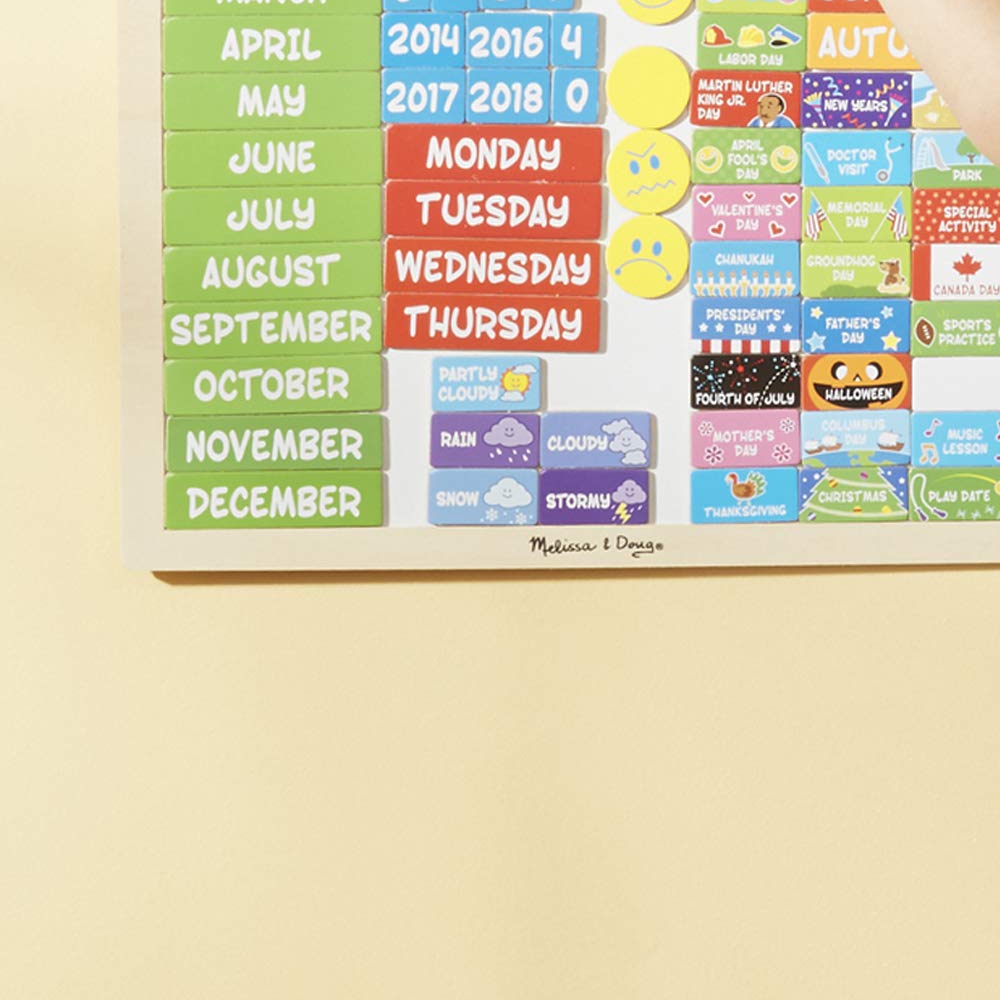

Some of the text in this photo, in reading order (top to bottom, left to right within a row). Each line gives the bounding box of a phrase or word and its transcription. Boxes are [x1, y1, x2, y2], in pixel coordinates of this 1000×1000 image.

[220, 28, 322, 61] APRIL
[387, 24, 460, 55] 2014
[469, 25, 543, 58] 2016
[561, 25, 582, 59] 4
[817, 25, 915, 60] AUTU
[719, 53, 783, 68] LABOR DAY
[698, 78, 793, 94] MARTIN LUTHER
[237, 84, 306, 118] MAY
[386, 82, 459, 114] 2017
[469, 82, 543, 113] 2018
[565, 79, 589, 112] 0
[697, 92, 747, 108] KING JR.
[824, 99, 888, 114] NEW YEARS
[697, 108, 720, 121] DAY
[730, 139, 764, 153] APRIL
[228, 141, 316, 174] JUNE
[426, 136, 561, 172] MONDAY
[727, 153, 768, 167] FOOL'S
[827, 149, 877, 162] DOCTOR
[736, 167, 760, 180] DAY
[838, 162, 869, 177] VISIT
[953, 168, 983, 182] PARK
[227, 197, 316, 232] JULY
[416, 192, 569, 229] TUESDAY
[711, 203, 783, 218] VALENTINE'S
[827, 201, 887, 215] MEMORIAL
[944, 206, 993, 220] SPECIAL
[736, 217, 760, 231] DAY
[846, 214, 868, 228] DAY
[938, 218, 997, 234] ACTIVITY
[715, 252, 773, 266] CHANUKAH
[806, 254, 875, 269] GROUNDHOG
[201, 254, 341, 289] AUGUST
[395, 250, 592, 287] WEDNESDAY
[832, 267, 855, 282] DAY
[934, 284, 1000, 298] CANADA DAY
[171, 310, 372, 345] SEPTEMBER
[404, 305, 583, 341] THURSDAY
[735, 321, 758, 336] DAY
[826, 316, 881, 330] FATHER'S
[943, 318, 992, 333] SPORTS
[841, 331, 865, 345] DAY
[938, 332, 996, 347] PRACTICE
[439, 367, 498, 382] PARTLY
[193, 367, 350, 402] OCTOBER
[438, 384, 500, 402] CLOUDY
[695, 391, 795, 406] FOURTH OF JULY
[825, 386, 893, 402] HALLOWEEN
[821, 418, 886, 433] COLUMBUS
[440, 431, 477, 447] RAIN
[712, 429, 775, 444] MOTHER'S
[844, 432, 867, 446] DAY
[947, 428, 984, 442] MUSIC
[185, 428, 363, 463] NOVEMBER
[547, 435, 608, 453] CLOUDY
[735, 443, 759, 457] DAY
[942, 441, 988, 456] LESSON
[186, 486, 361, 519] DECEMBER
[435, 490, 480, 507] SNOW
[546, 493, 611, 510] STORMY
[818, 490, 887, 503] CHRISTMAS
[929, 490, 991, 504] PLAY DATE
[704, 505, 787, 519] THANKSGIVING
[530, 536, 597, 556] Melissa
